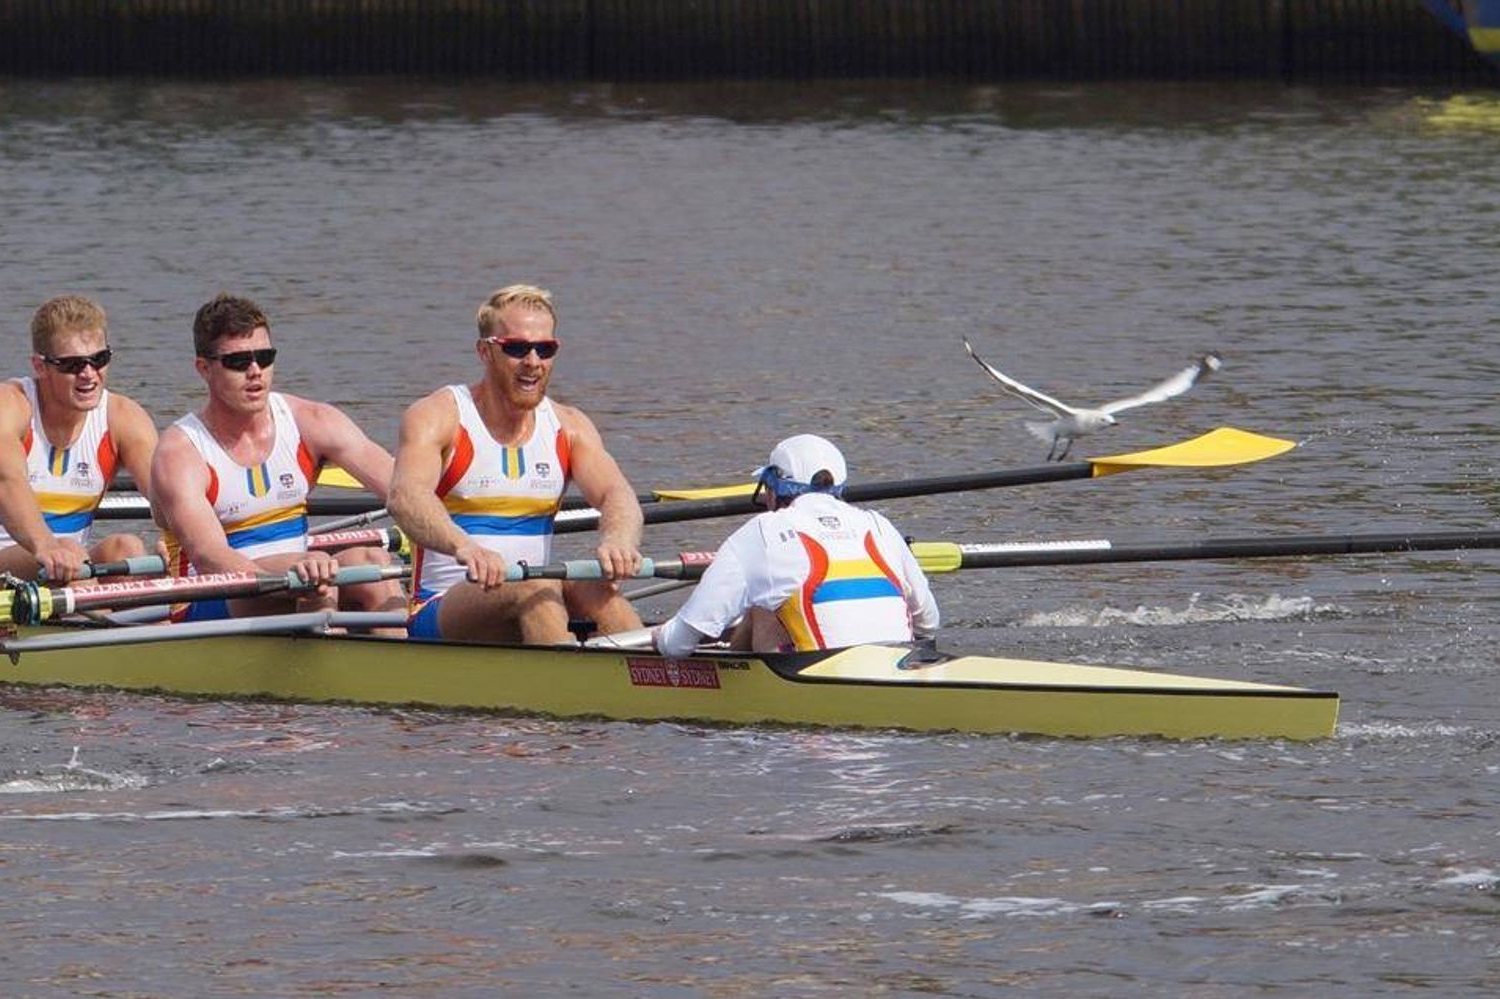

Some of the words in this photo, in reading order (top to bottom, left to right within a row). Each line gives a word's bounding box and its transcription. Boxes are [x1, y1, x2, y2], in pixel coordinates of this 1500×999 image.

[75, 579, 148, 595] SYDNEY
[177, 571, 249, 587] SYDNEY
[631, 667, 666, 684] SYDNEY
[679, 669, 717, 686] SYDNEY
